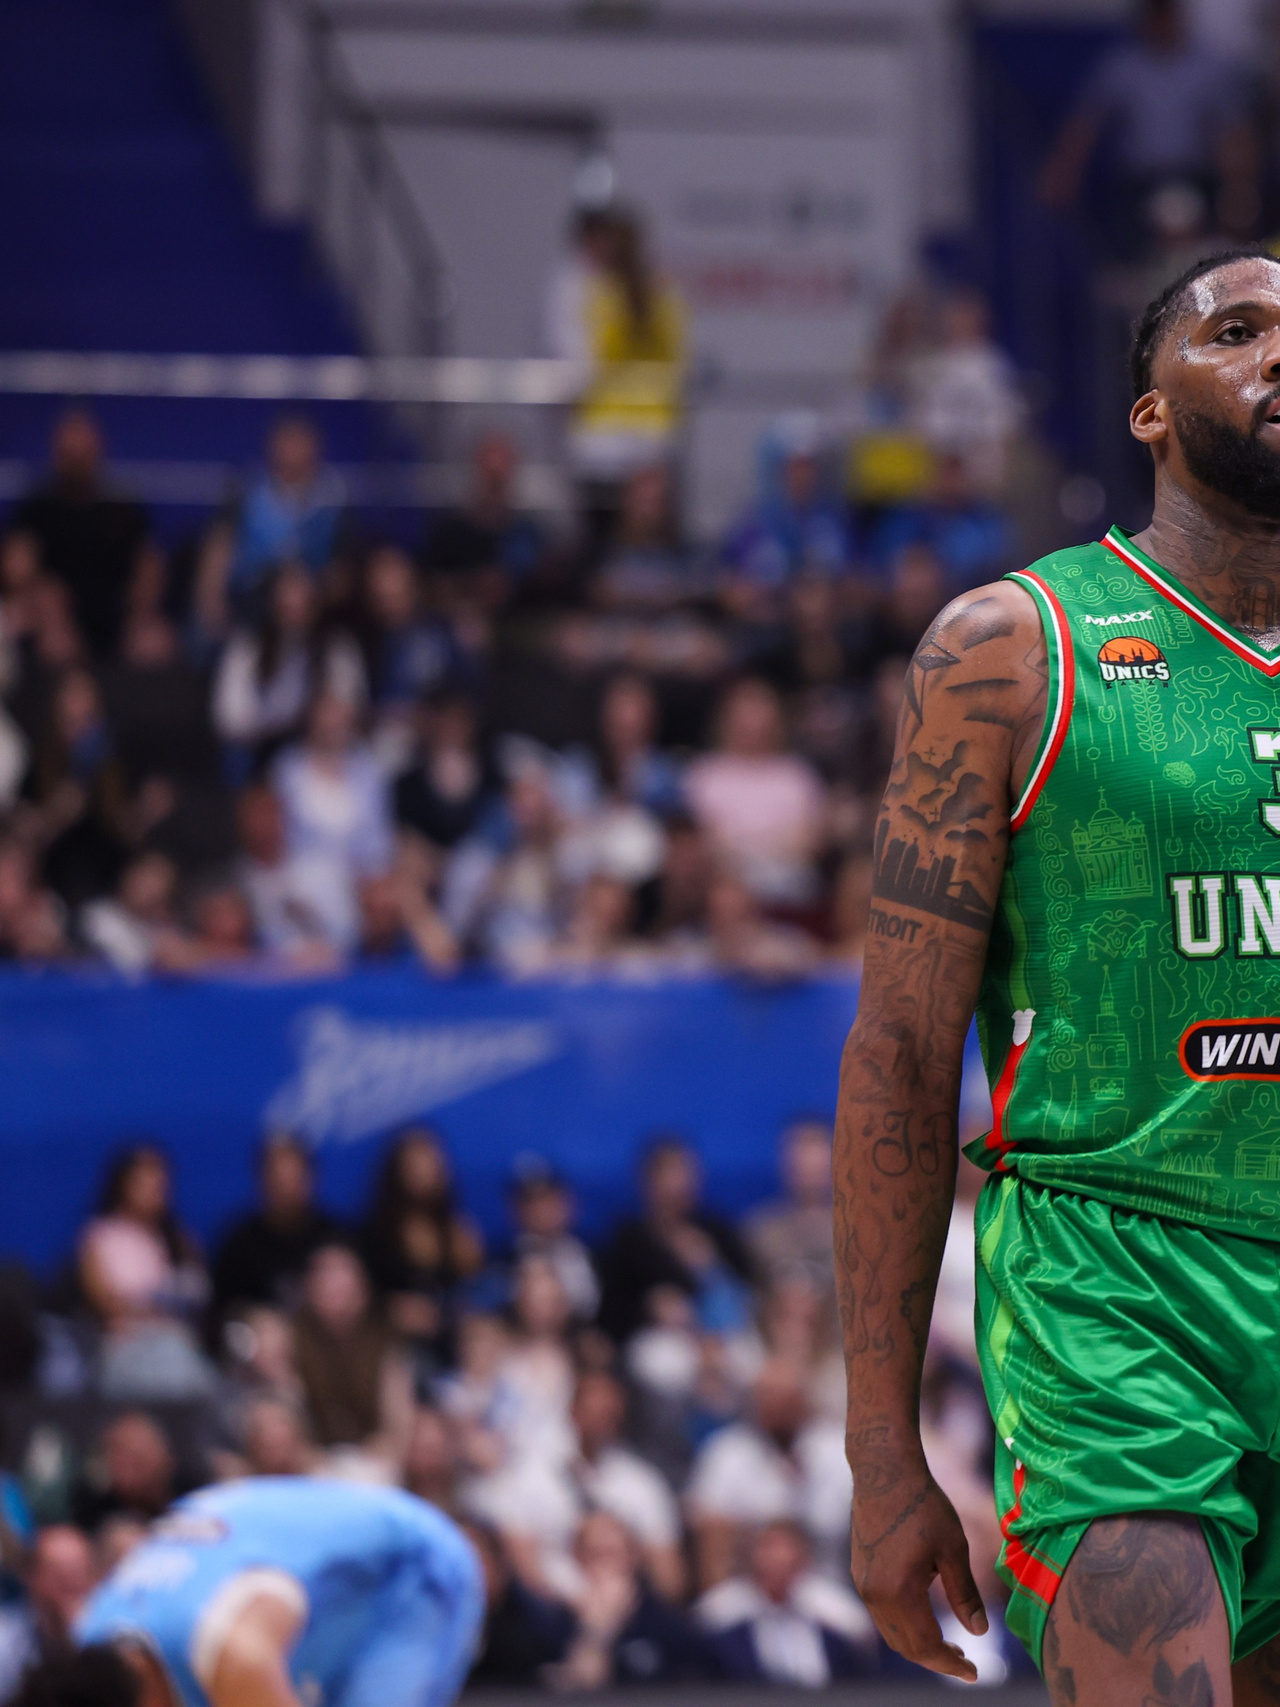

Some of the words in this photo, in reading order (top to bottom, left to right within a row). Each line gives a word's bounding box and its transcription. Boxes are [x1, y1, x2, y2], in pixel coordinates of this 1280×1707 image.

[1085, 610, 1154, 626] MAXX
[1099, 661, 1170, 682] UNICS
[868, 908, 923, 944] TROIT
